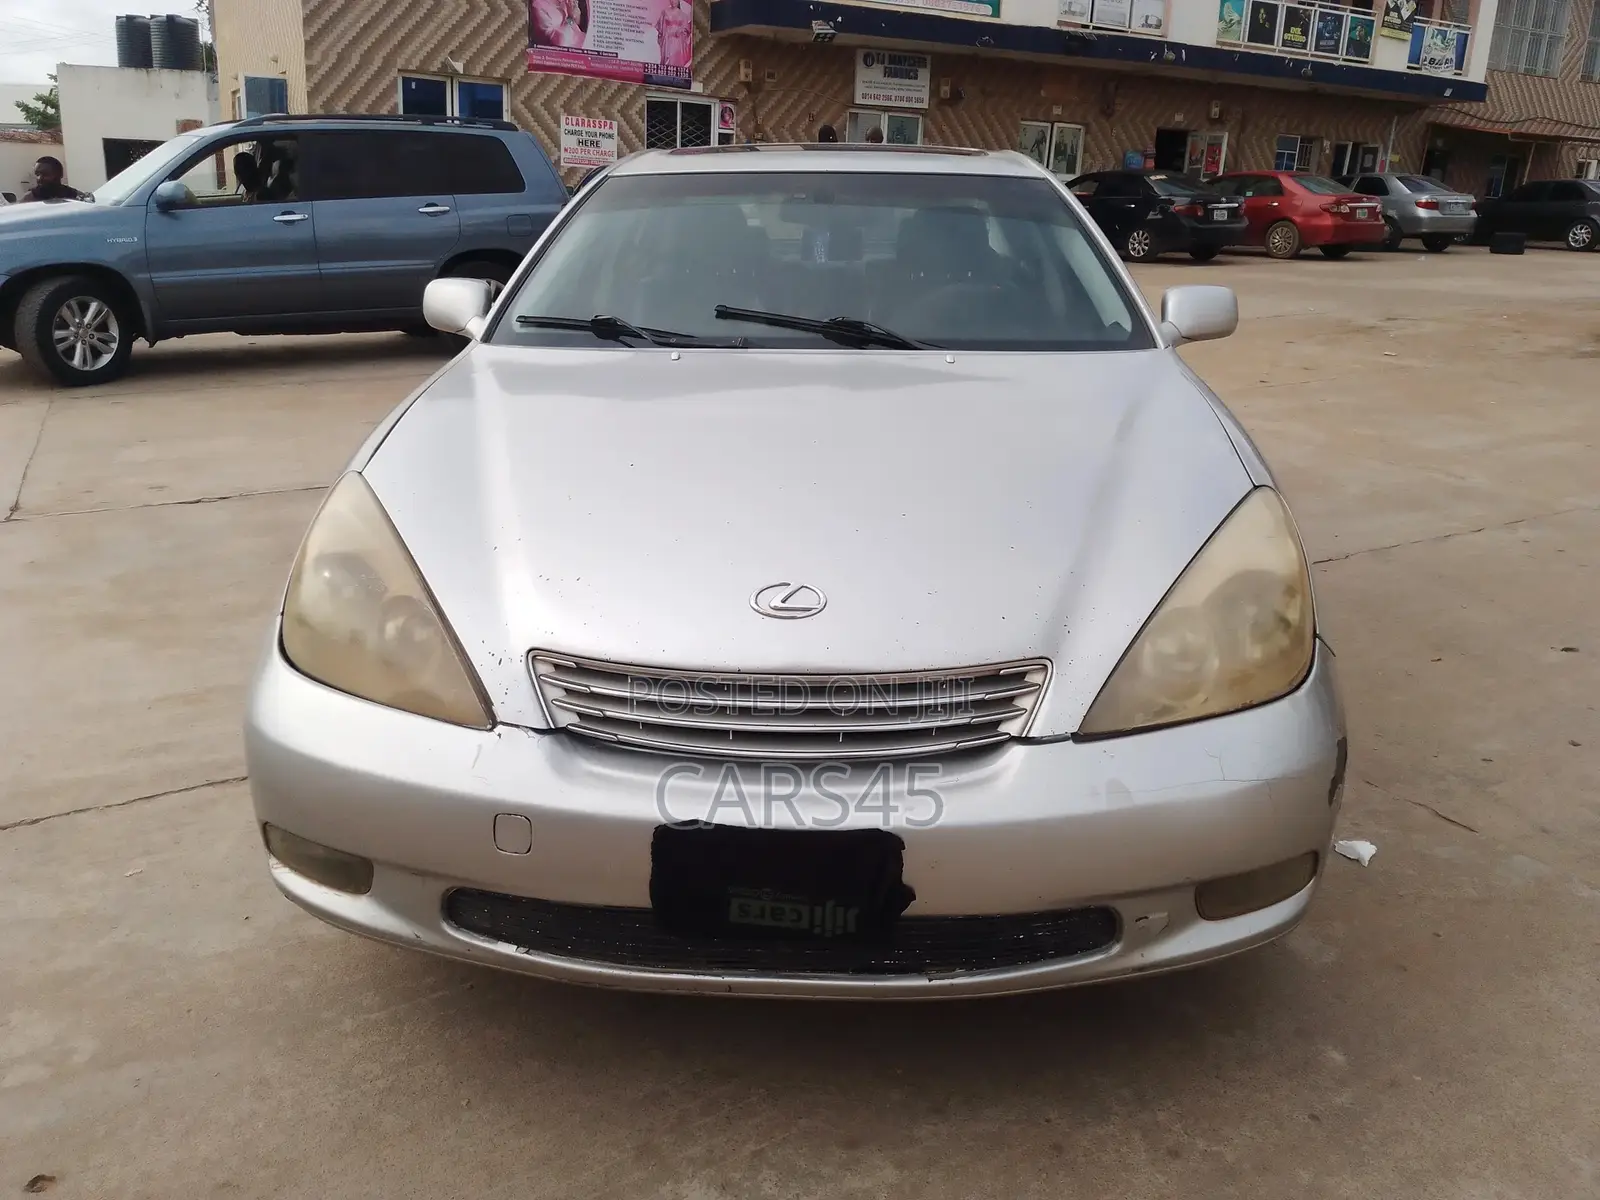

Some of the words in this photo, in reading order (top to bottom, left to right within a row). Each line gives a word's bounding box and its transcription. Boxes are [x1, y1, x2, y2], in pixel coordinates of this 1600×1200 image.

[565, 117, 614, 130] CLARASSPA
[564, 128, 583, 137] CHARGE
[584, 130, 598, 138] YOUR
[598, 132, 615, 140] PHONE
[578, 139, 601, 148] HERE
[580, 148, 591, 156] PER
[592, 149, 615, 157] CHARGE
[737, 903, 802, 924] cars
